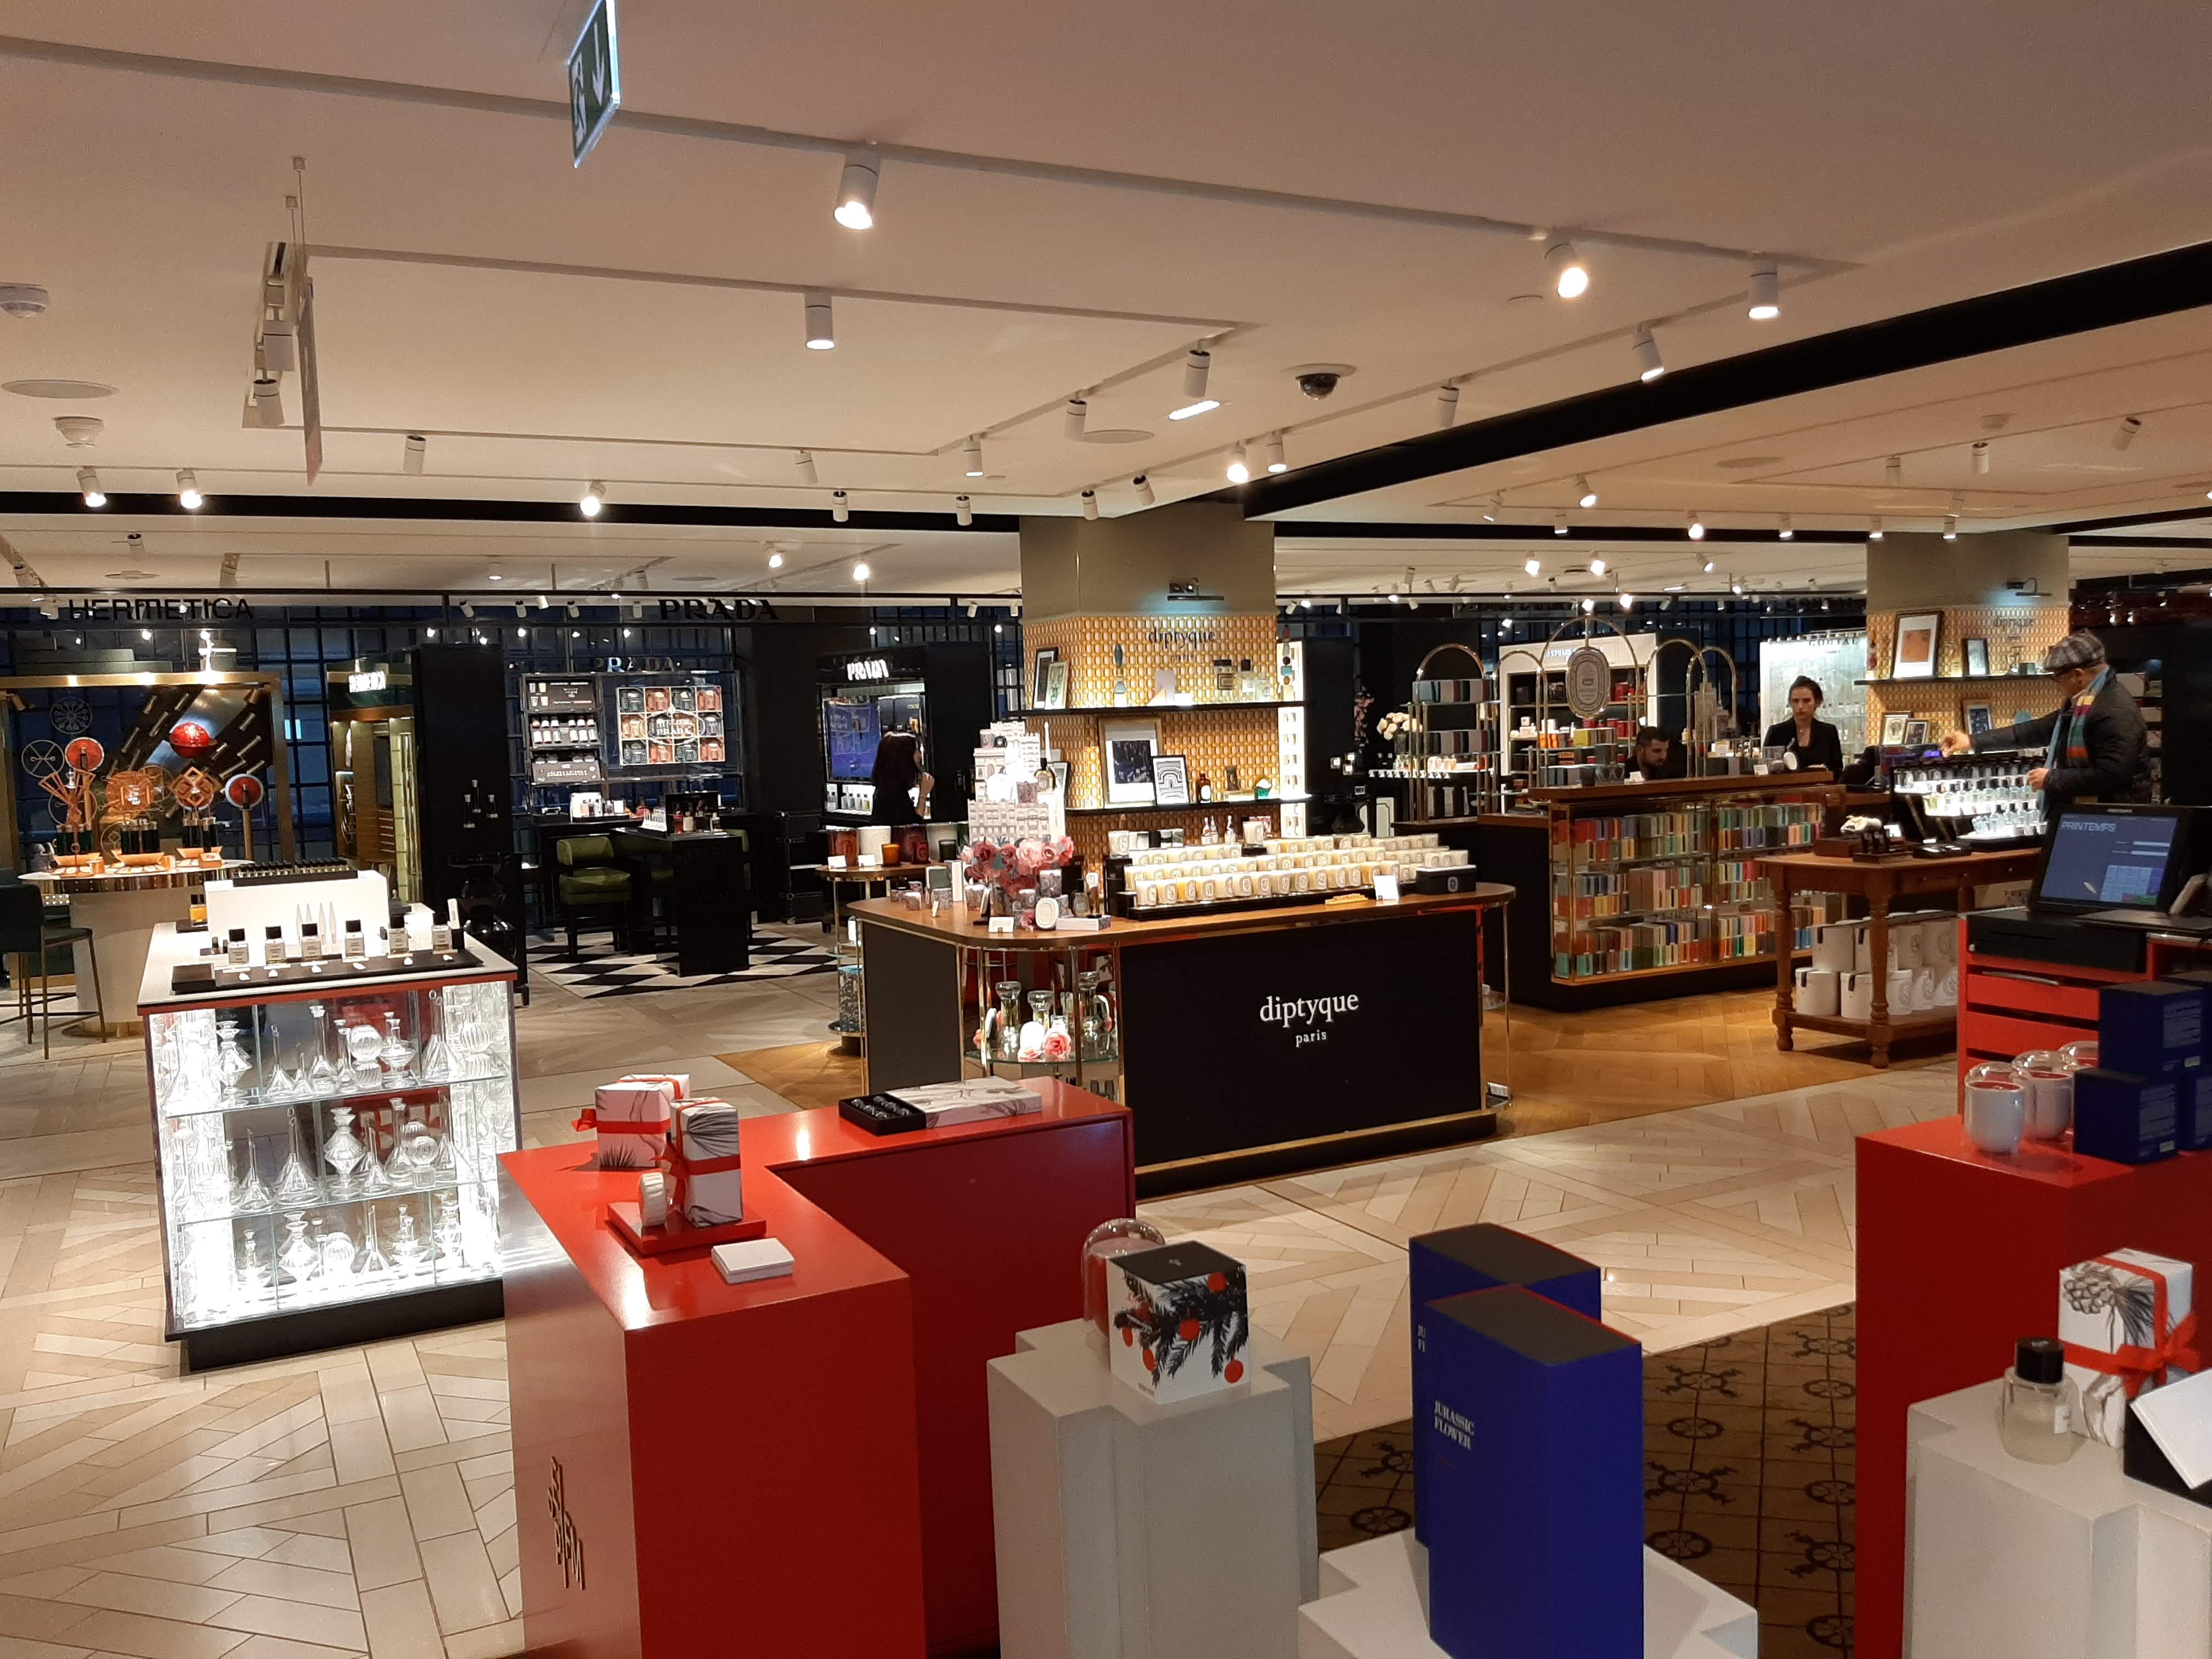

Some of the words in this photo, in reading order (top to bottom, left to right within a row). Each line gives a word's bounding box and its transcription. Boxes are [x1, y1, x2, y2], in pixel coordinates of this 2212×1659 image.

[69, 599, 254, 619] HERMETICA
[657, 599, 779, 620] PRADA
[1149, 627, 1215, 651] diptyque
[2061, 822, 2115, 832] PRINTEMPS
[1260, 994, 1359, 1028] diptyque
[1295, 1029, 1327, 1048] paris
[1434, 1400, 1475, 1435] JURASSIC
[1434, 1416, 1471, 1450] FLOWER
